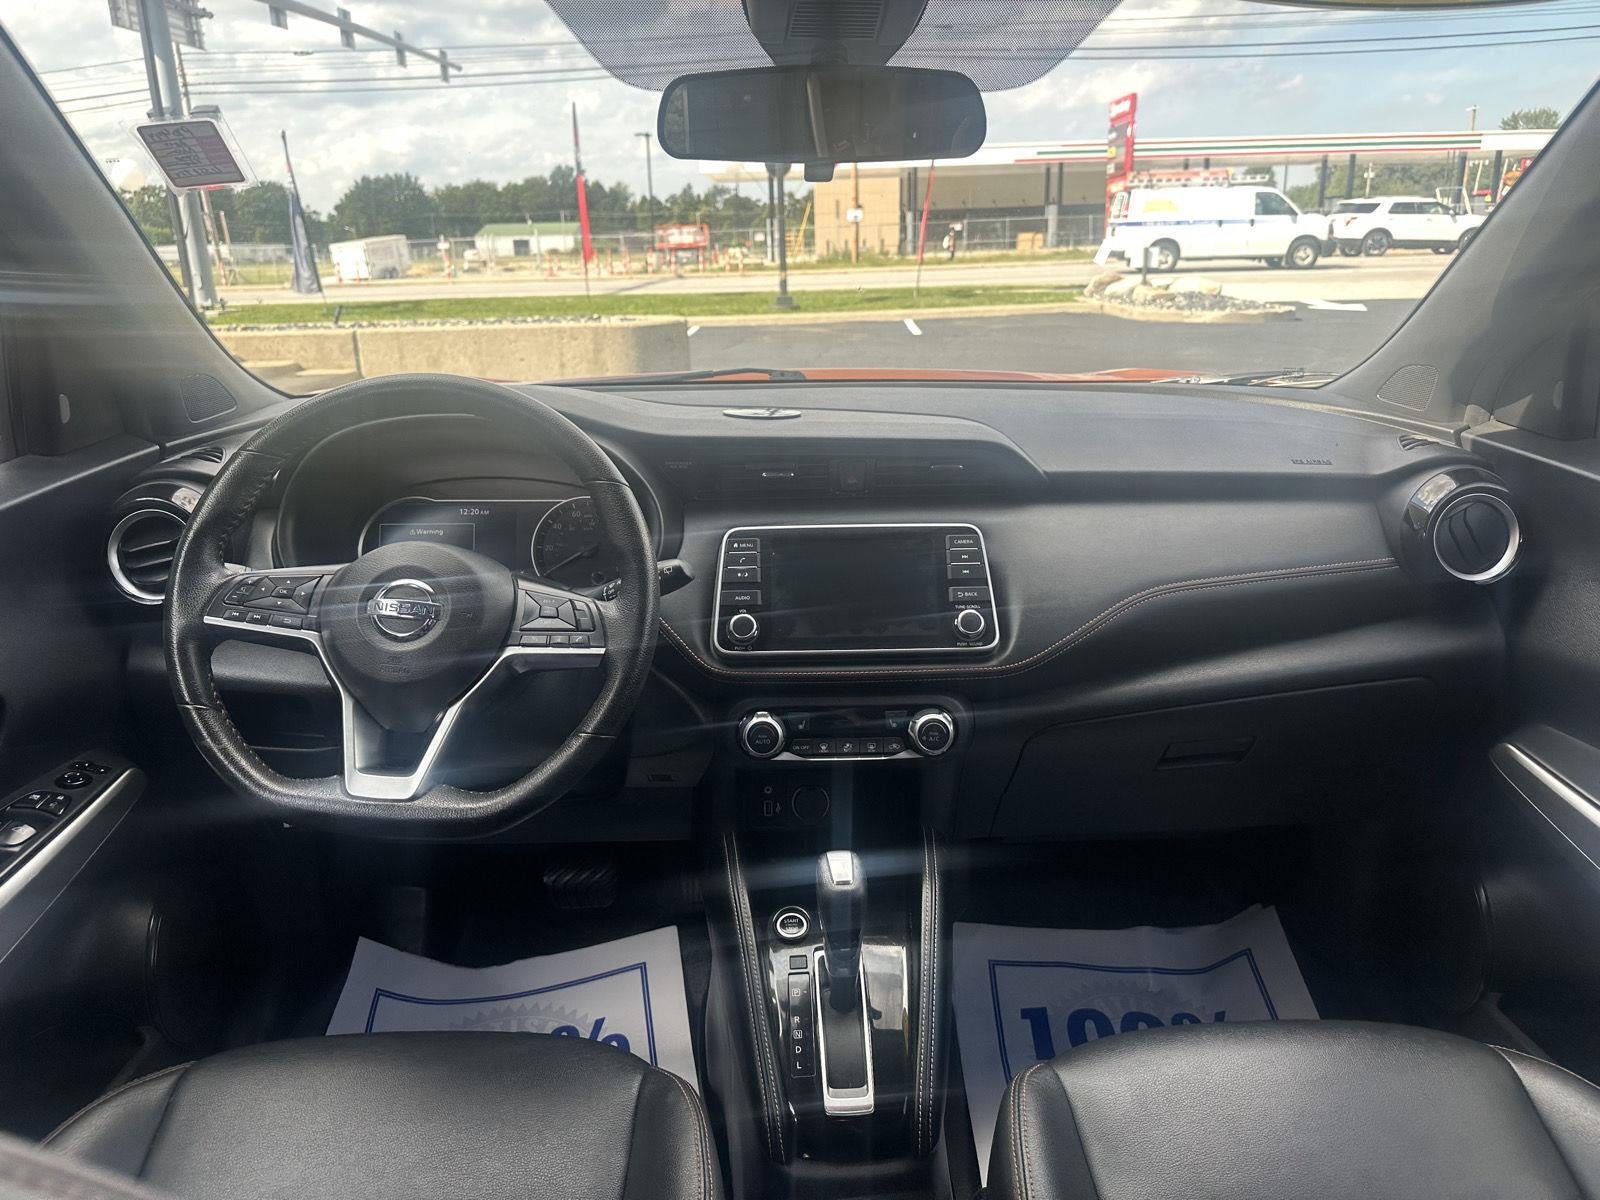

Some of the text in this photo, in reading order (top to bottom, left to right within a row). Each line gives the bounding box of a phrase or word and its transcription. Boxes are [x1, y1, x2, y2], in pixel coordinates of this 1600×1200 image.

[460, 508, 479, 516] 12:20
[373, 602, 435, 618] NISSAN
[794, 1016, 800, 1024] R
[795, 1045, 802, 1054] D
[796, 1061, 802, 1069] L
